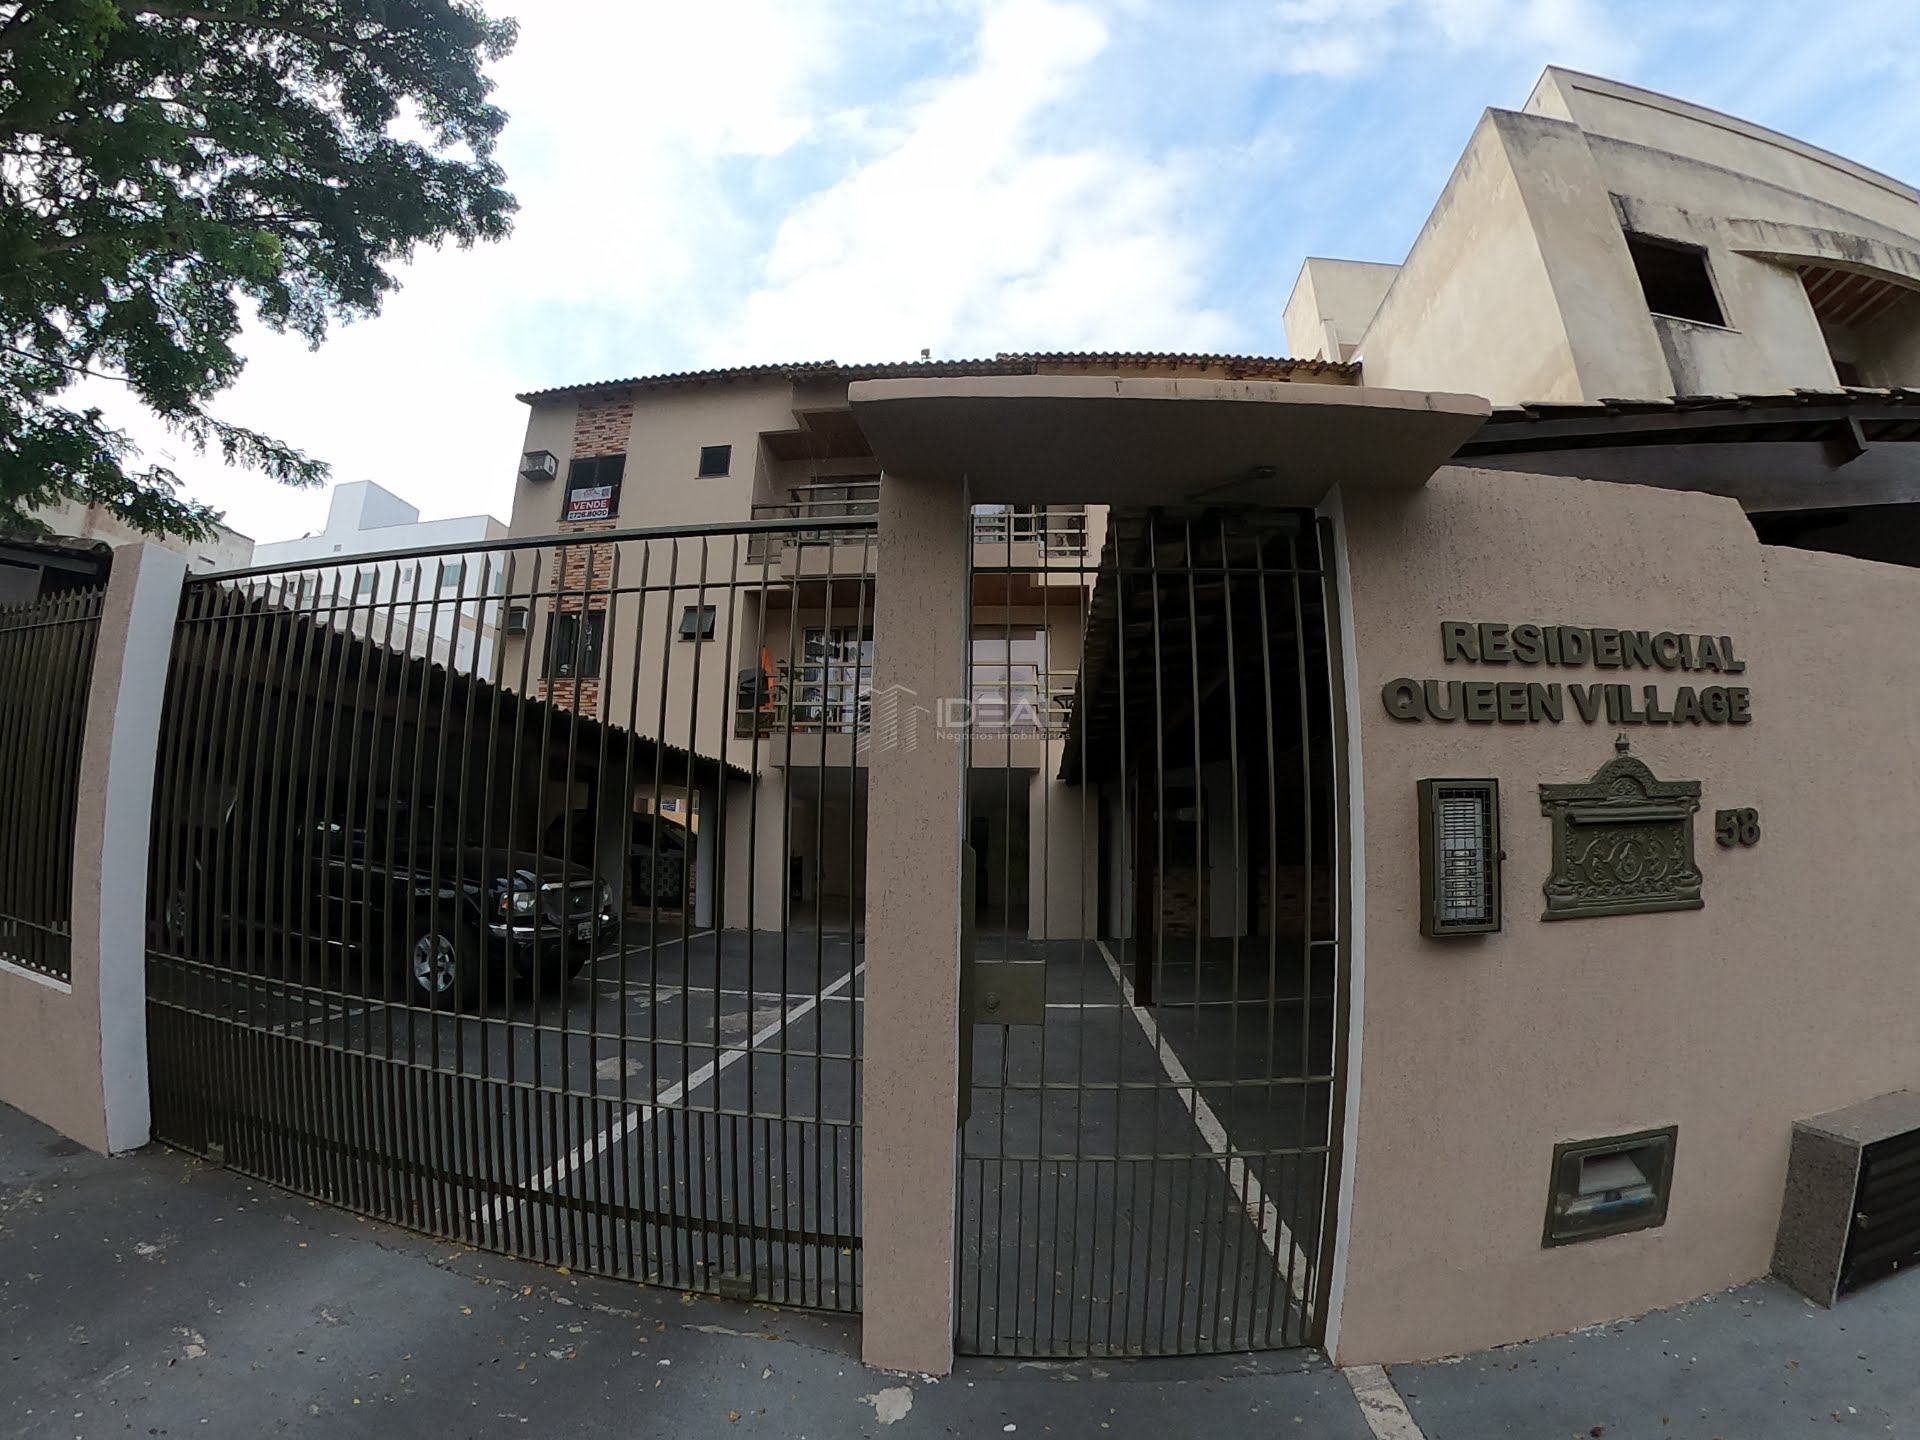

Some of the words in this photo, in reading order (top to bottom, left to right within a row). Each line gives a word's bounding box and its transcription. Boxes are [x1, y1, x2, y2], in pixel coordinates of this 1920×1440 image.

[574, 501, 607, 509] VENDE
[1441, 622, 1745, 670] RESIDENCIAL
[1382, 678, 1563, 722] QUEEN
[1569, 683, 1752, 724] VILLAGE
[1715, 808, 1761, 847] 58
